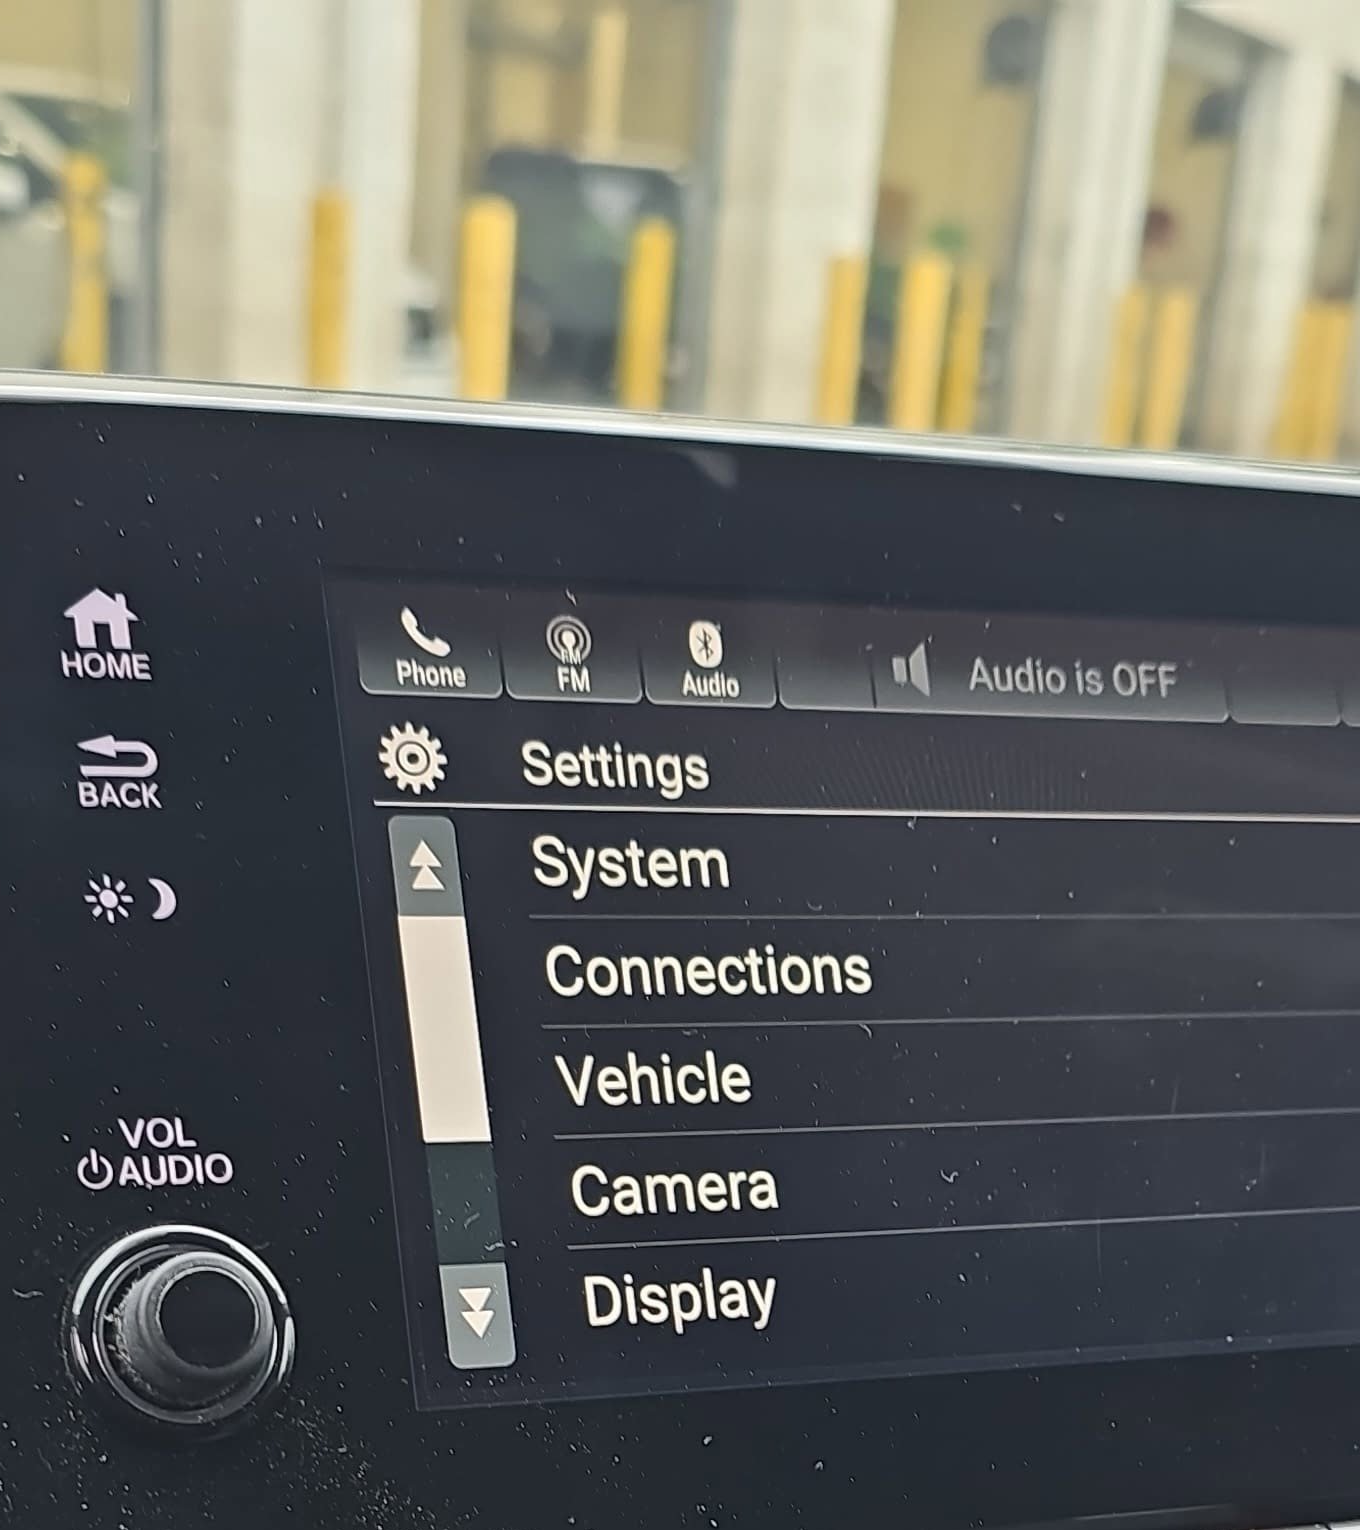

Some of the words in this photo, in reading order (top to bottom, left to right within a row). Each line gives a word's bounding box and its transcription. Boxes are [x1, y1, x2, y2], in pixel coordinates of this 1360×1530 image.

[61, 648, 151, 680] HOME
[397, 659, 465, 687] Phone
[558, 666, 590, 692] FM
[970, 657, 1066, 694] Audio
[1075, 662, 1104, 695] is
[1113, 663, 1175, 698] OFF
[683, 671, 739, 697] Audio
[522, 741, 709, 799] Settings
[78, 782, 161, 808] BACK
[533, 836, 729, 899] System
[546, 945, 872, 996] Connections
[555, 1051, 751, 1105] Vehicle
[118, 1117, 196, 1148] VOL
[119, 1154, 233, 1189] AUDIO
[572, 1165, 778, 1216] Camera
[584, 1268, 775, 1334] Display
